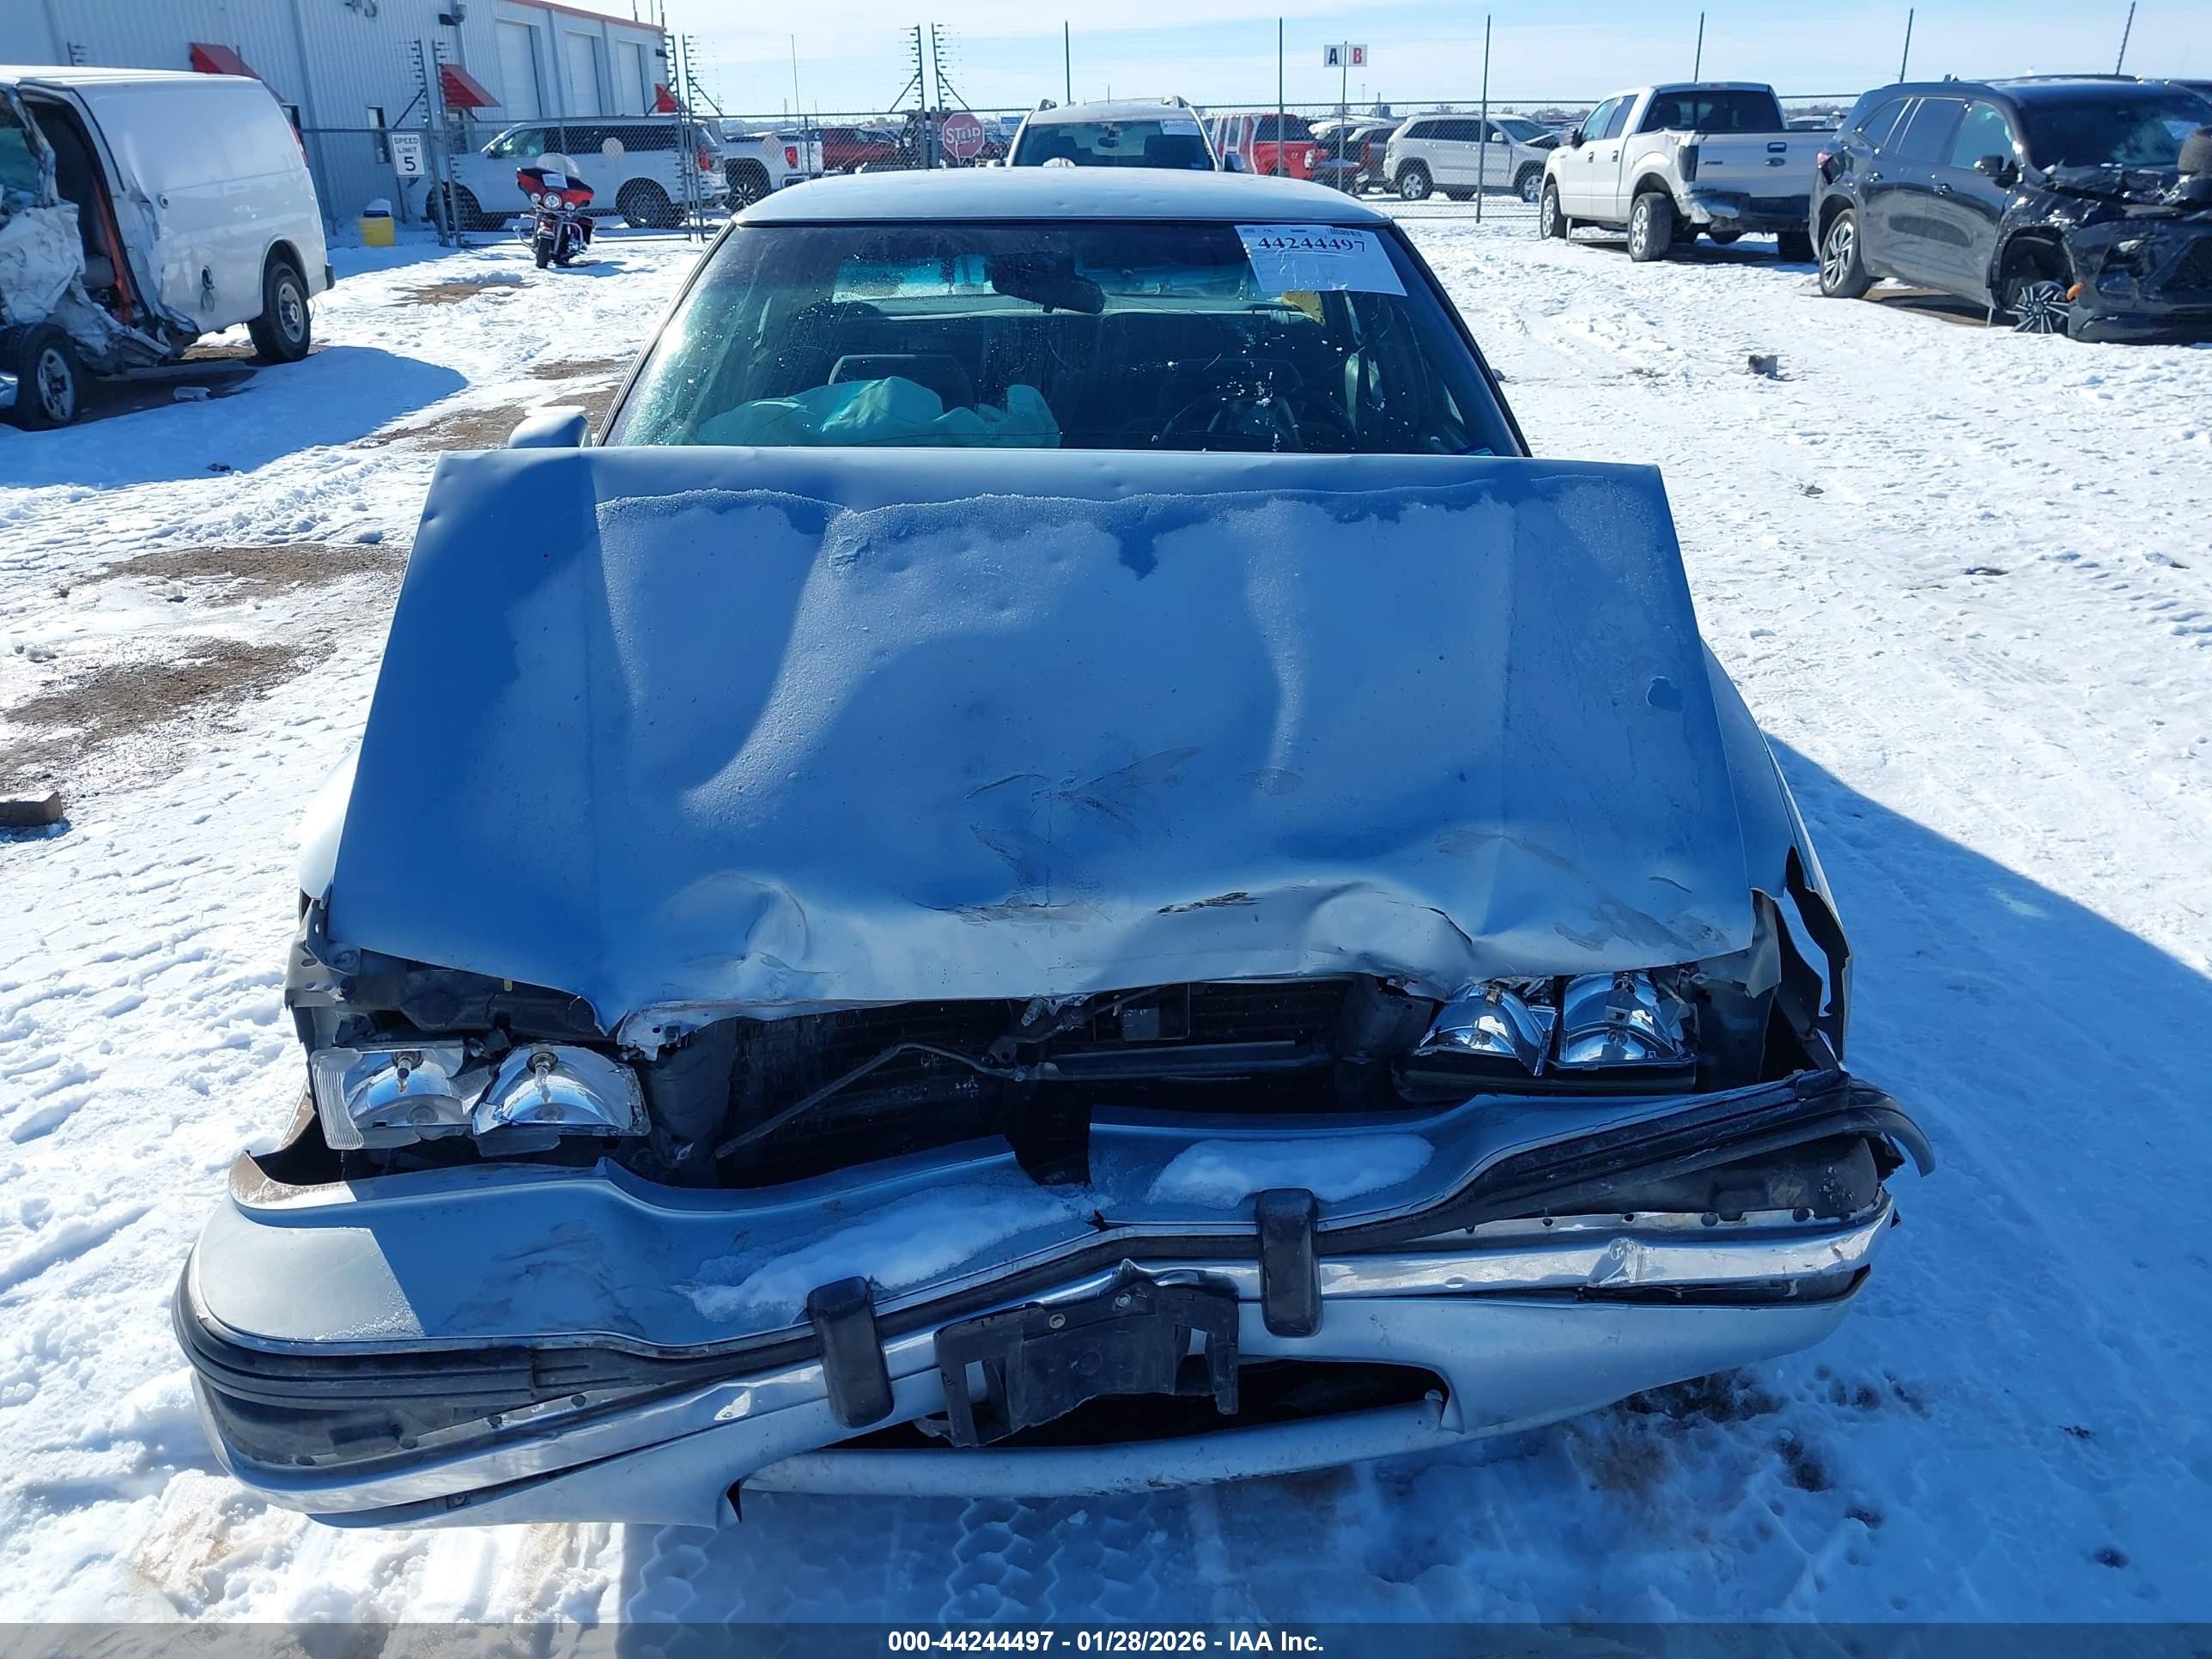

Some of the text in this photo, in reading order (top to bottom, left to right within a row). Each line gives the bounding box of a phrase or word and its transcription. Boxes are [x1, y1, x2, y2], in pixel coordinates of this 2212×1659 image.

[1328, 47, 1338, 64] A
[1352, 47, 1362, 64] B
[945, 127, 981, 144] STOP
[404, 156, 416, 172] 5
[1257, 237, 1365, 252] 44244497
